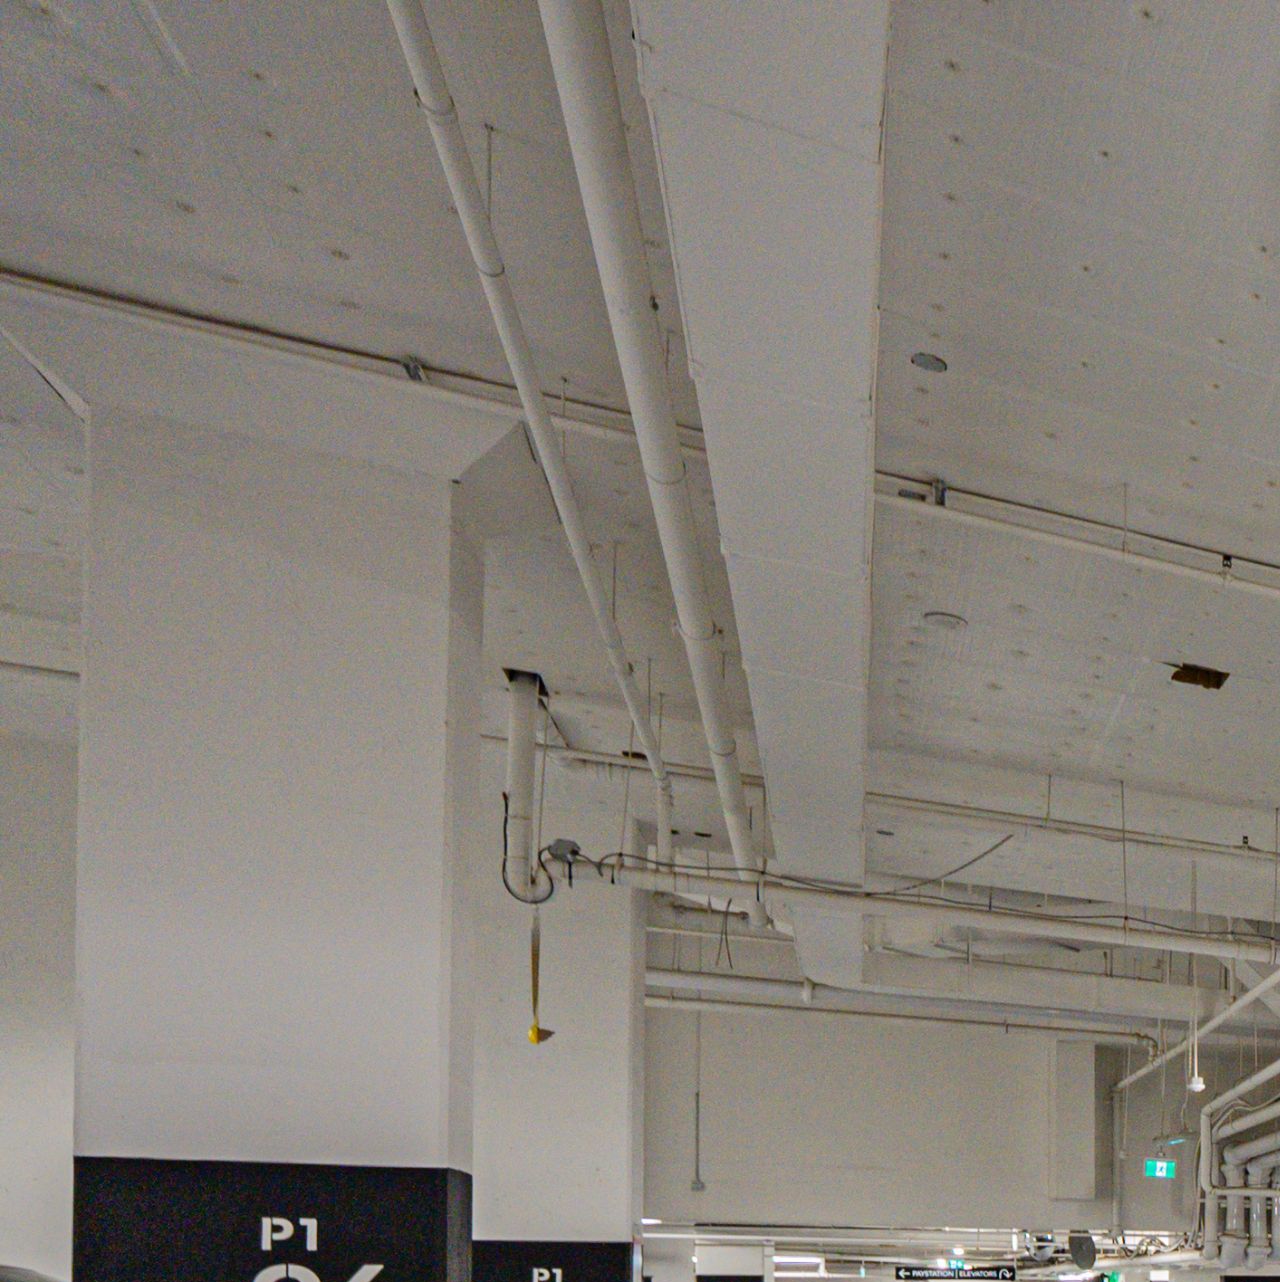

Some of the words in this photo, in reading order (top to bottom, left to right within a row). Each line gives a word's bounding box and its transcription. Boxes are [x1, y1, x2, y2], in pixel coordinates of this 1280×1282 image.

[261, 1217, 318, 1251] P1
[911, 1269, 955, 1278] PAYSTATION
[959, 1269, 998, 1278] ELEVATORS
